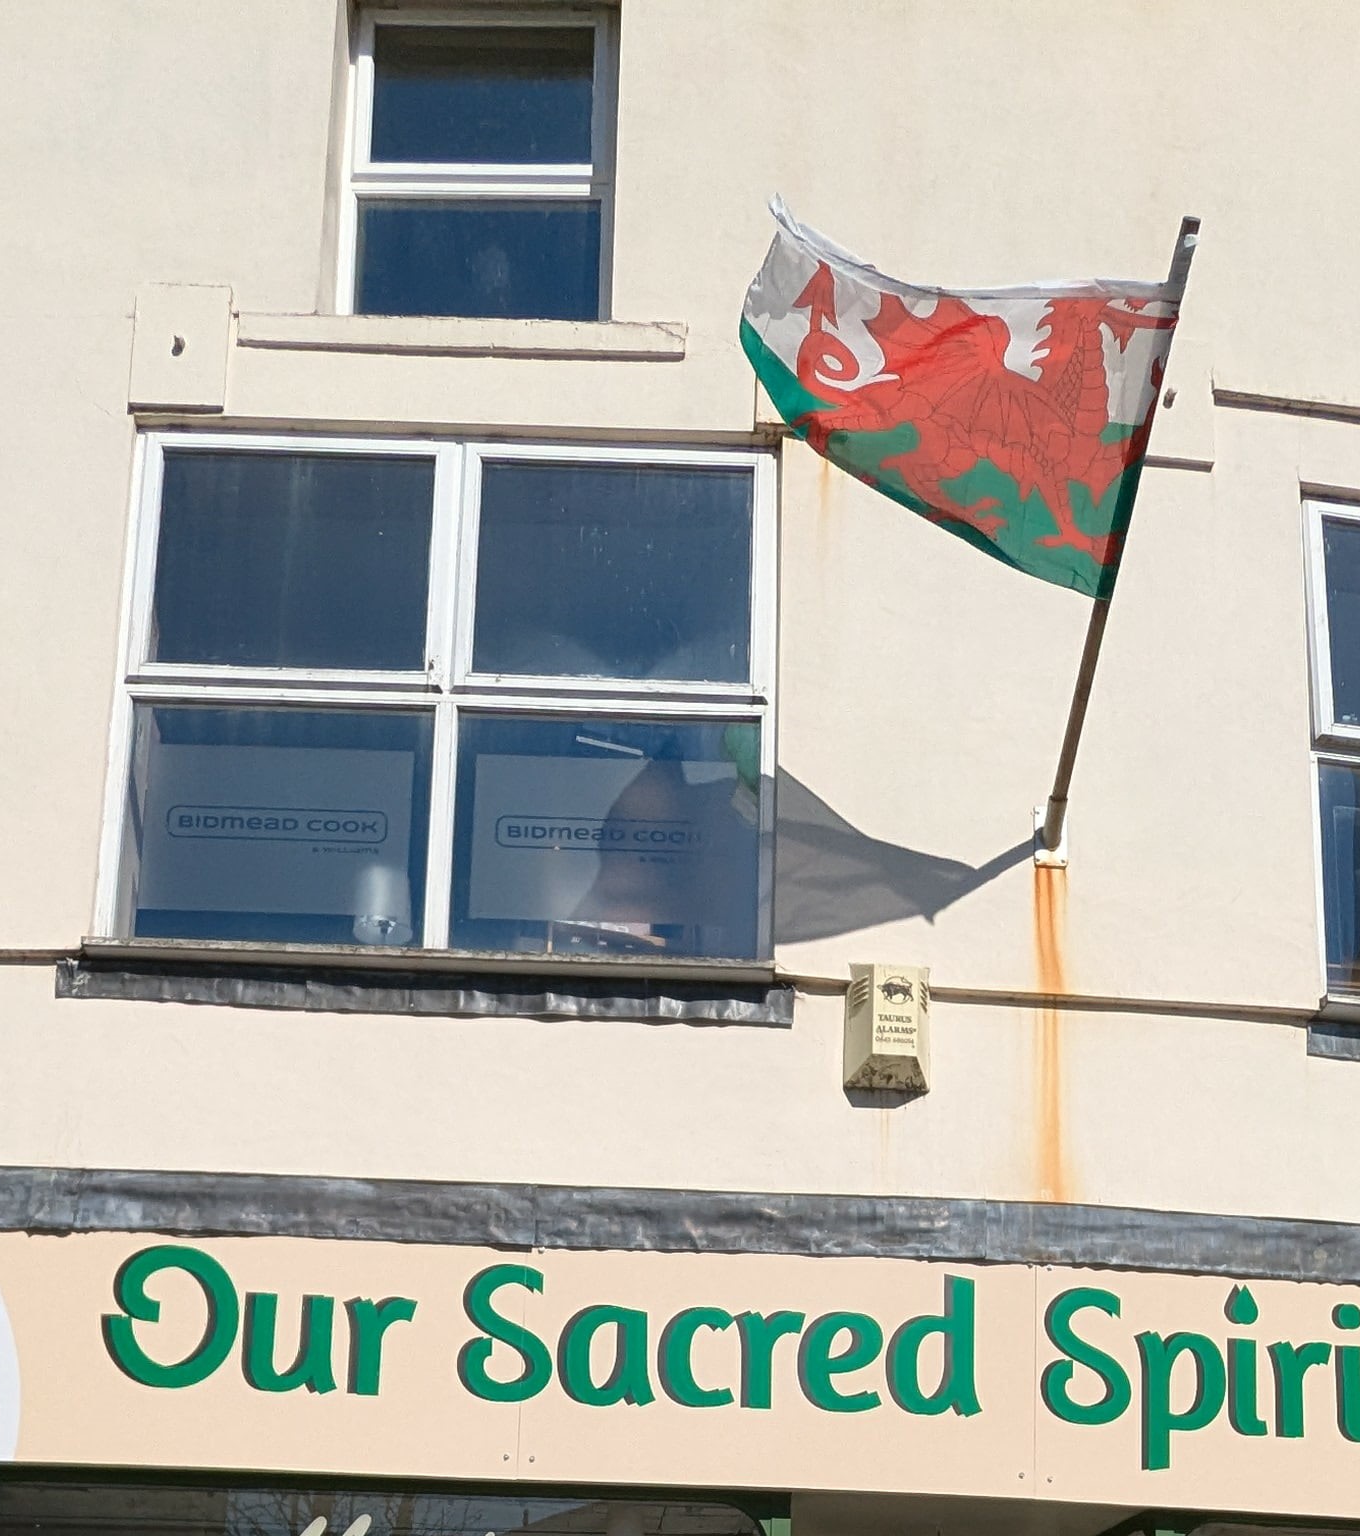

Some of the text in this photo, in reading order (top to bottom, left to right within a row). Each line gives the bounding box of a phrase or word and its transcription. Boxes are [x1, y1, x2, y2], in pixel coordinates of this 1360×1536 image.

[307, 819, 378, 834] COOK
[878, 1014, 913, 1023] TAURUS
[101, 1245, 417, 1396] Our
[457, 1264, 983, 1417] Sacred
